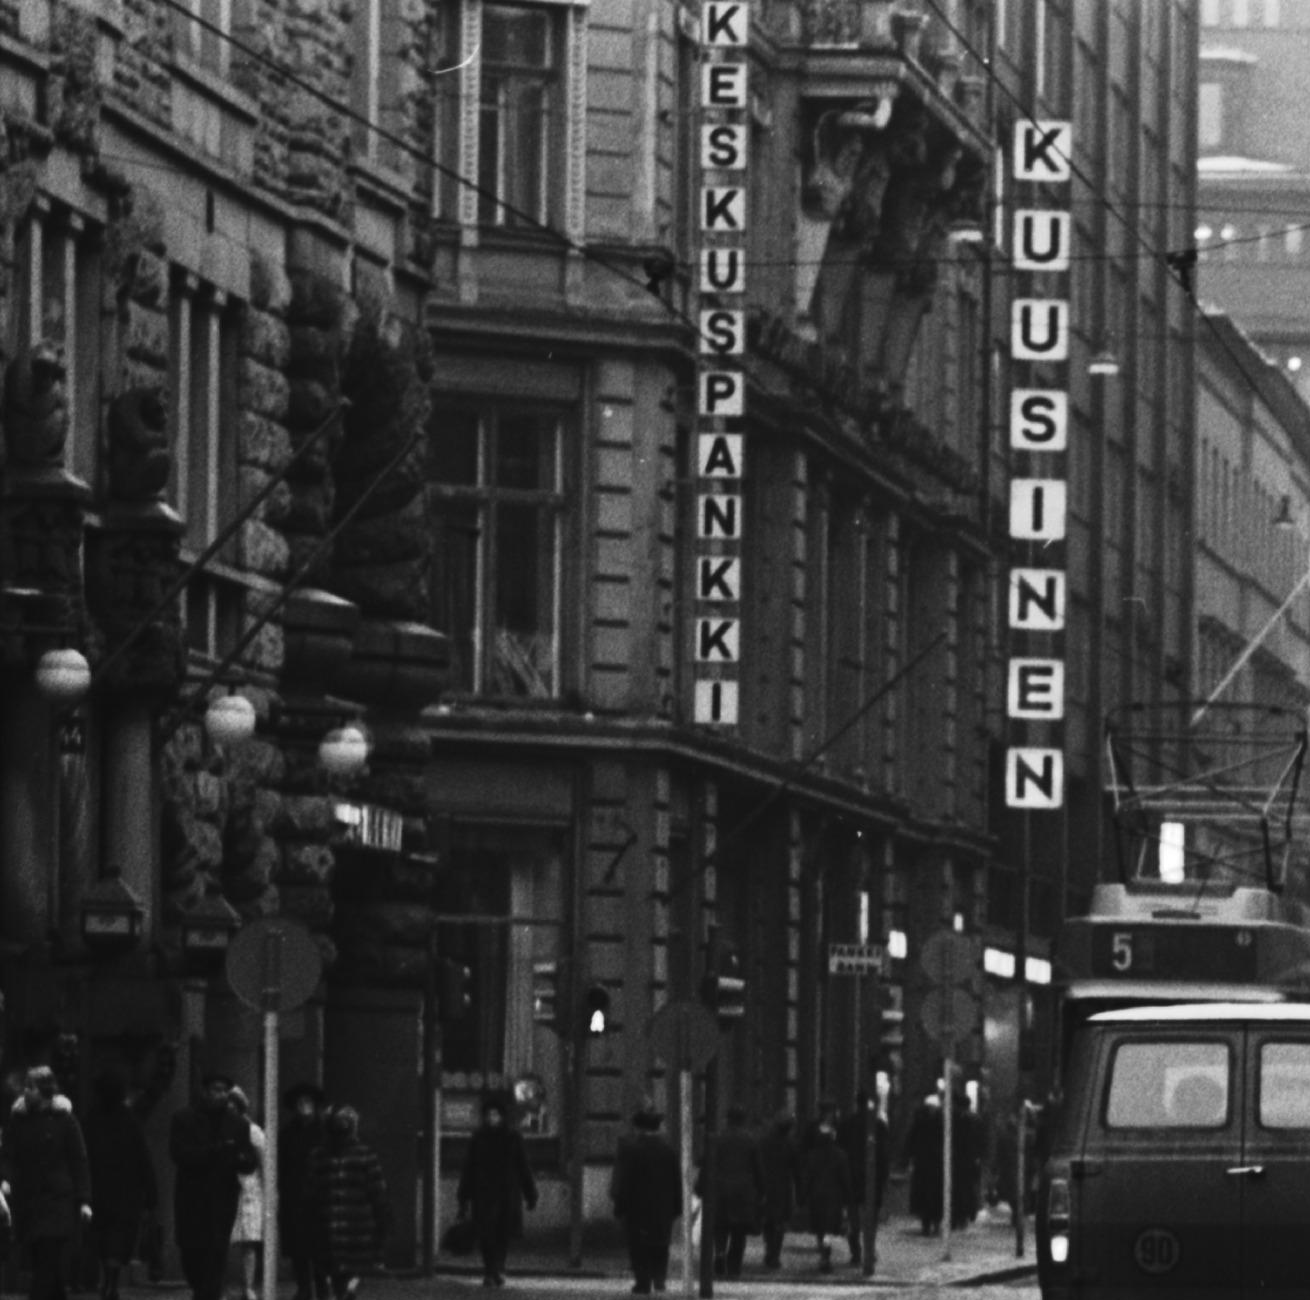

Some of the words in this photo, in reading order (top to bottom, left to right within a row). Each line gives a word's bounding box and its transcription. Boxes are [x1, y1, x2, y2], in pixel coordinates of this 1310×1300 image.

[699, 4, 742, 720] KESKUSPANKKI
[1014, 127, 1062, 800] KUUSINEN
[1112, 933, 1133, 971] 5
[1140, 1235, 1174, 1266] 90
